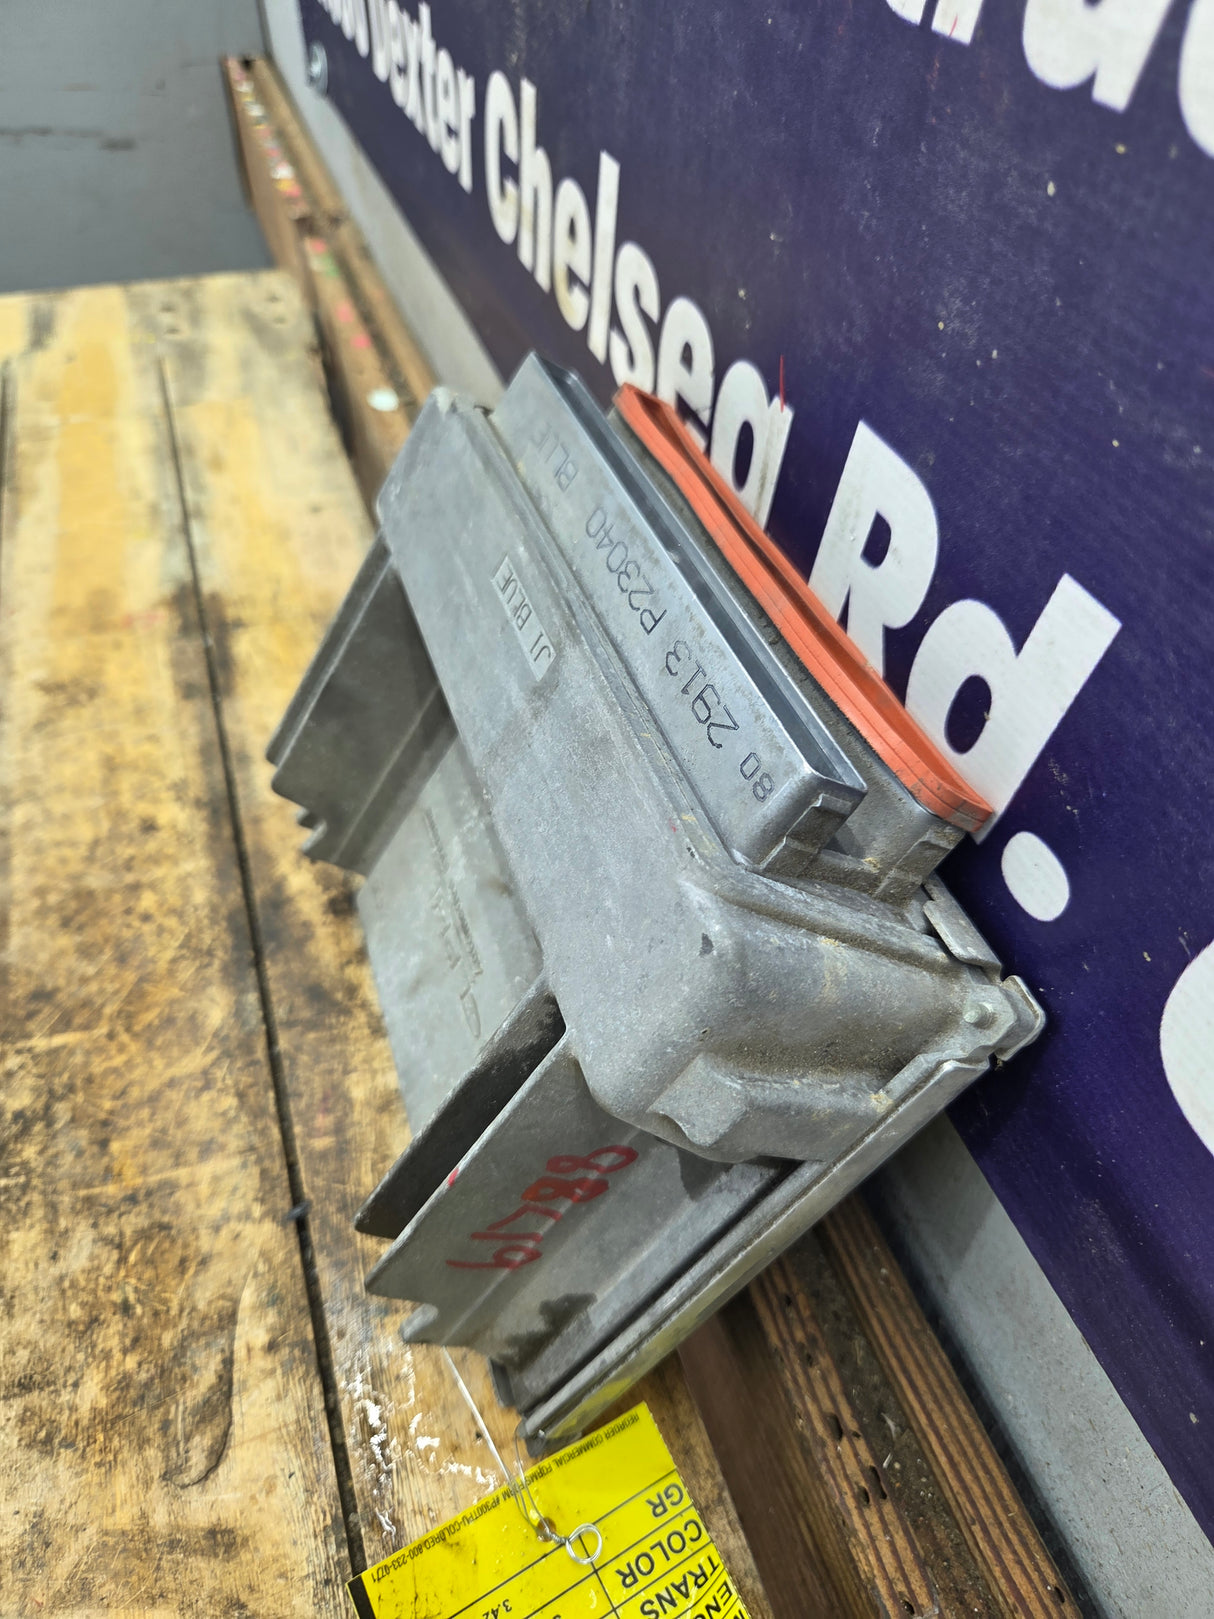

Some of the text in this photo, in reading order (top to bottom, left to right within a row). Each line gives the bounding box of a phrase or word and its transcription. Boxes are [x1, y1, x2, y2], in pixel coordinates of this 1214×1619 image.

[484, 70, 794, 533] Chelsea
[808, 420, 1122, 922] Rd.
[496, 563, 532, 631] BLUE
[585, 506, 667, 635] P23040
[665, 640, 740, 749] 2913
[554, 1435, 604, 1469] COMMERCIAL
[646, 1482, 684, 1518] GR
[615, 1519, 702, 1589] COLOR
[640, 1555, 720, 1619] TRANS
